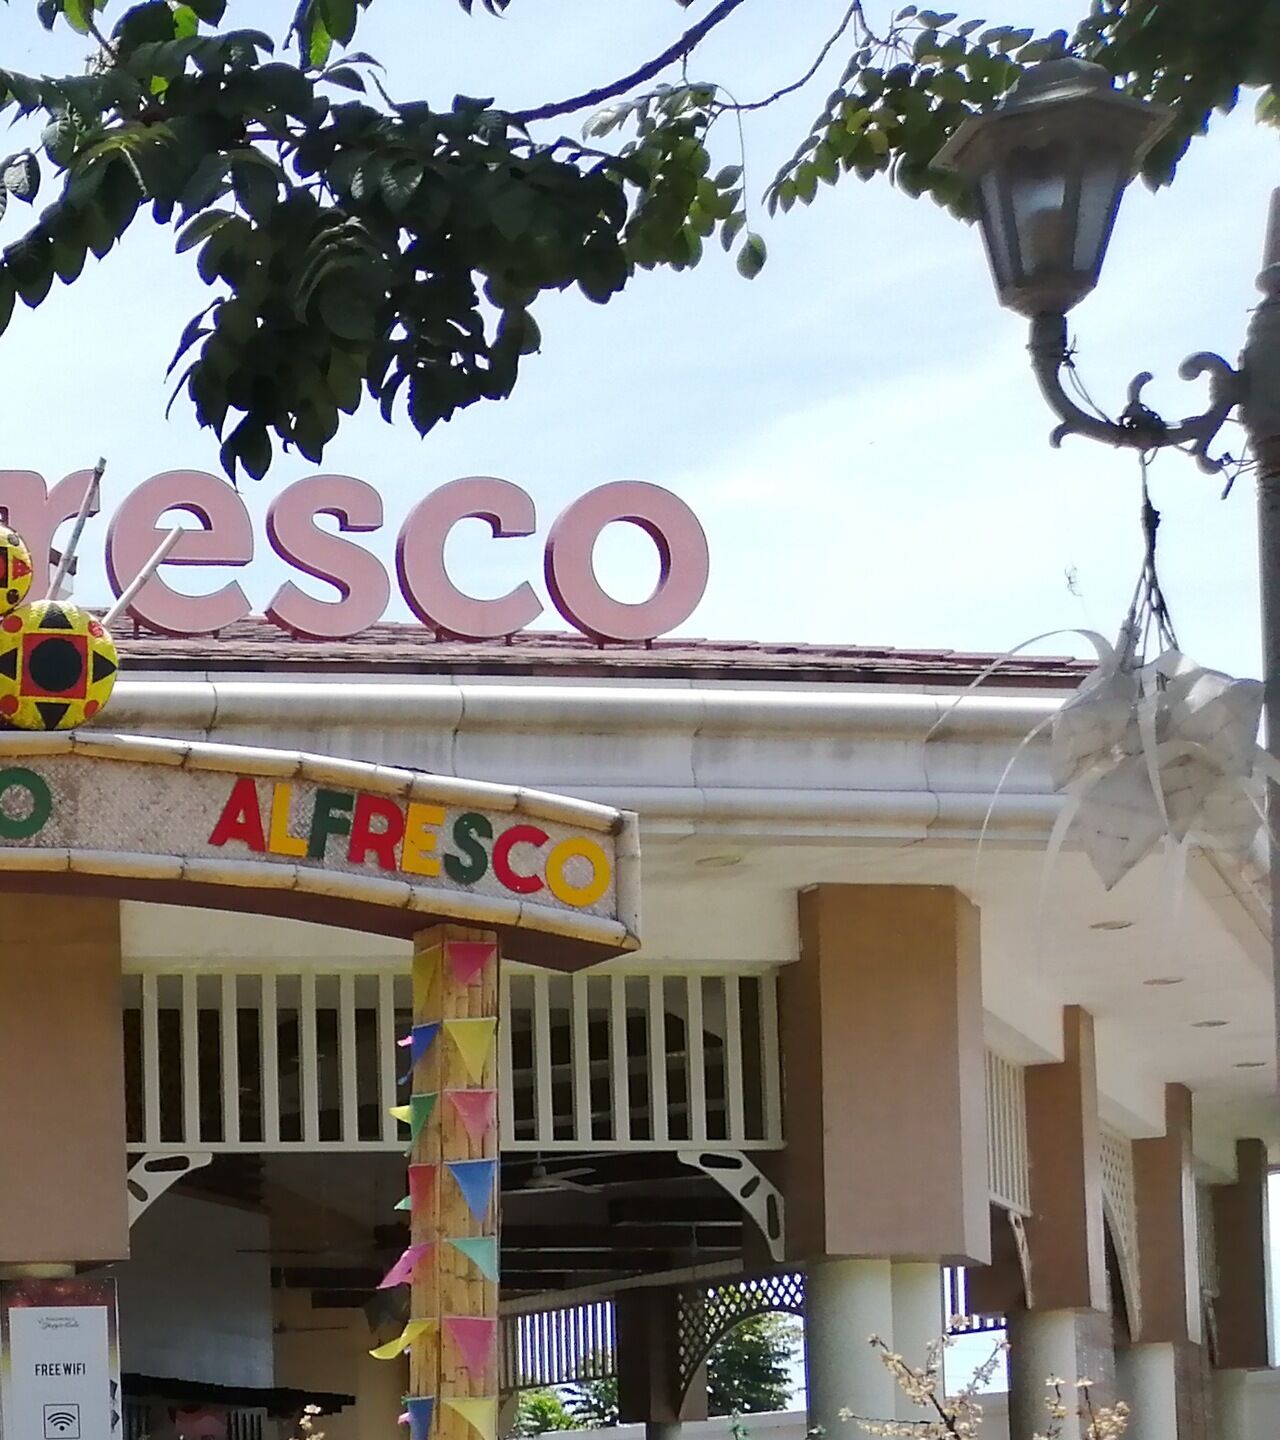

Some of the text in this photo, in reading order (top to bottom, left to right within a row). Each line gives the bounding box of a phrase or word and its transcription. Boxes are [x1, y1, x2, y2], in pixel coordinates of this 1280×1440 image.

[208, 777, 613, 907] ALFRESCO
[35, 1363, 86, 1376] FREE WIFI
